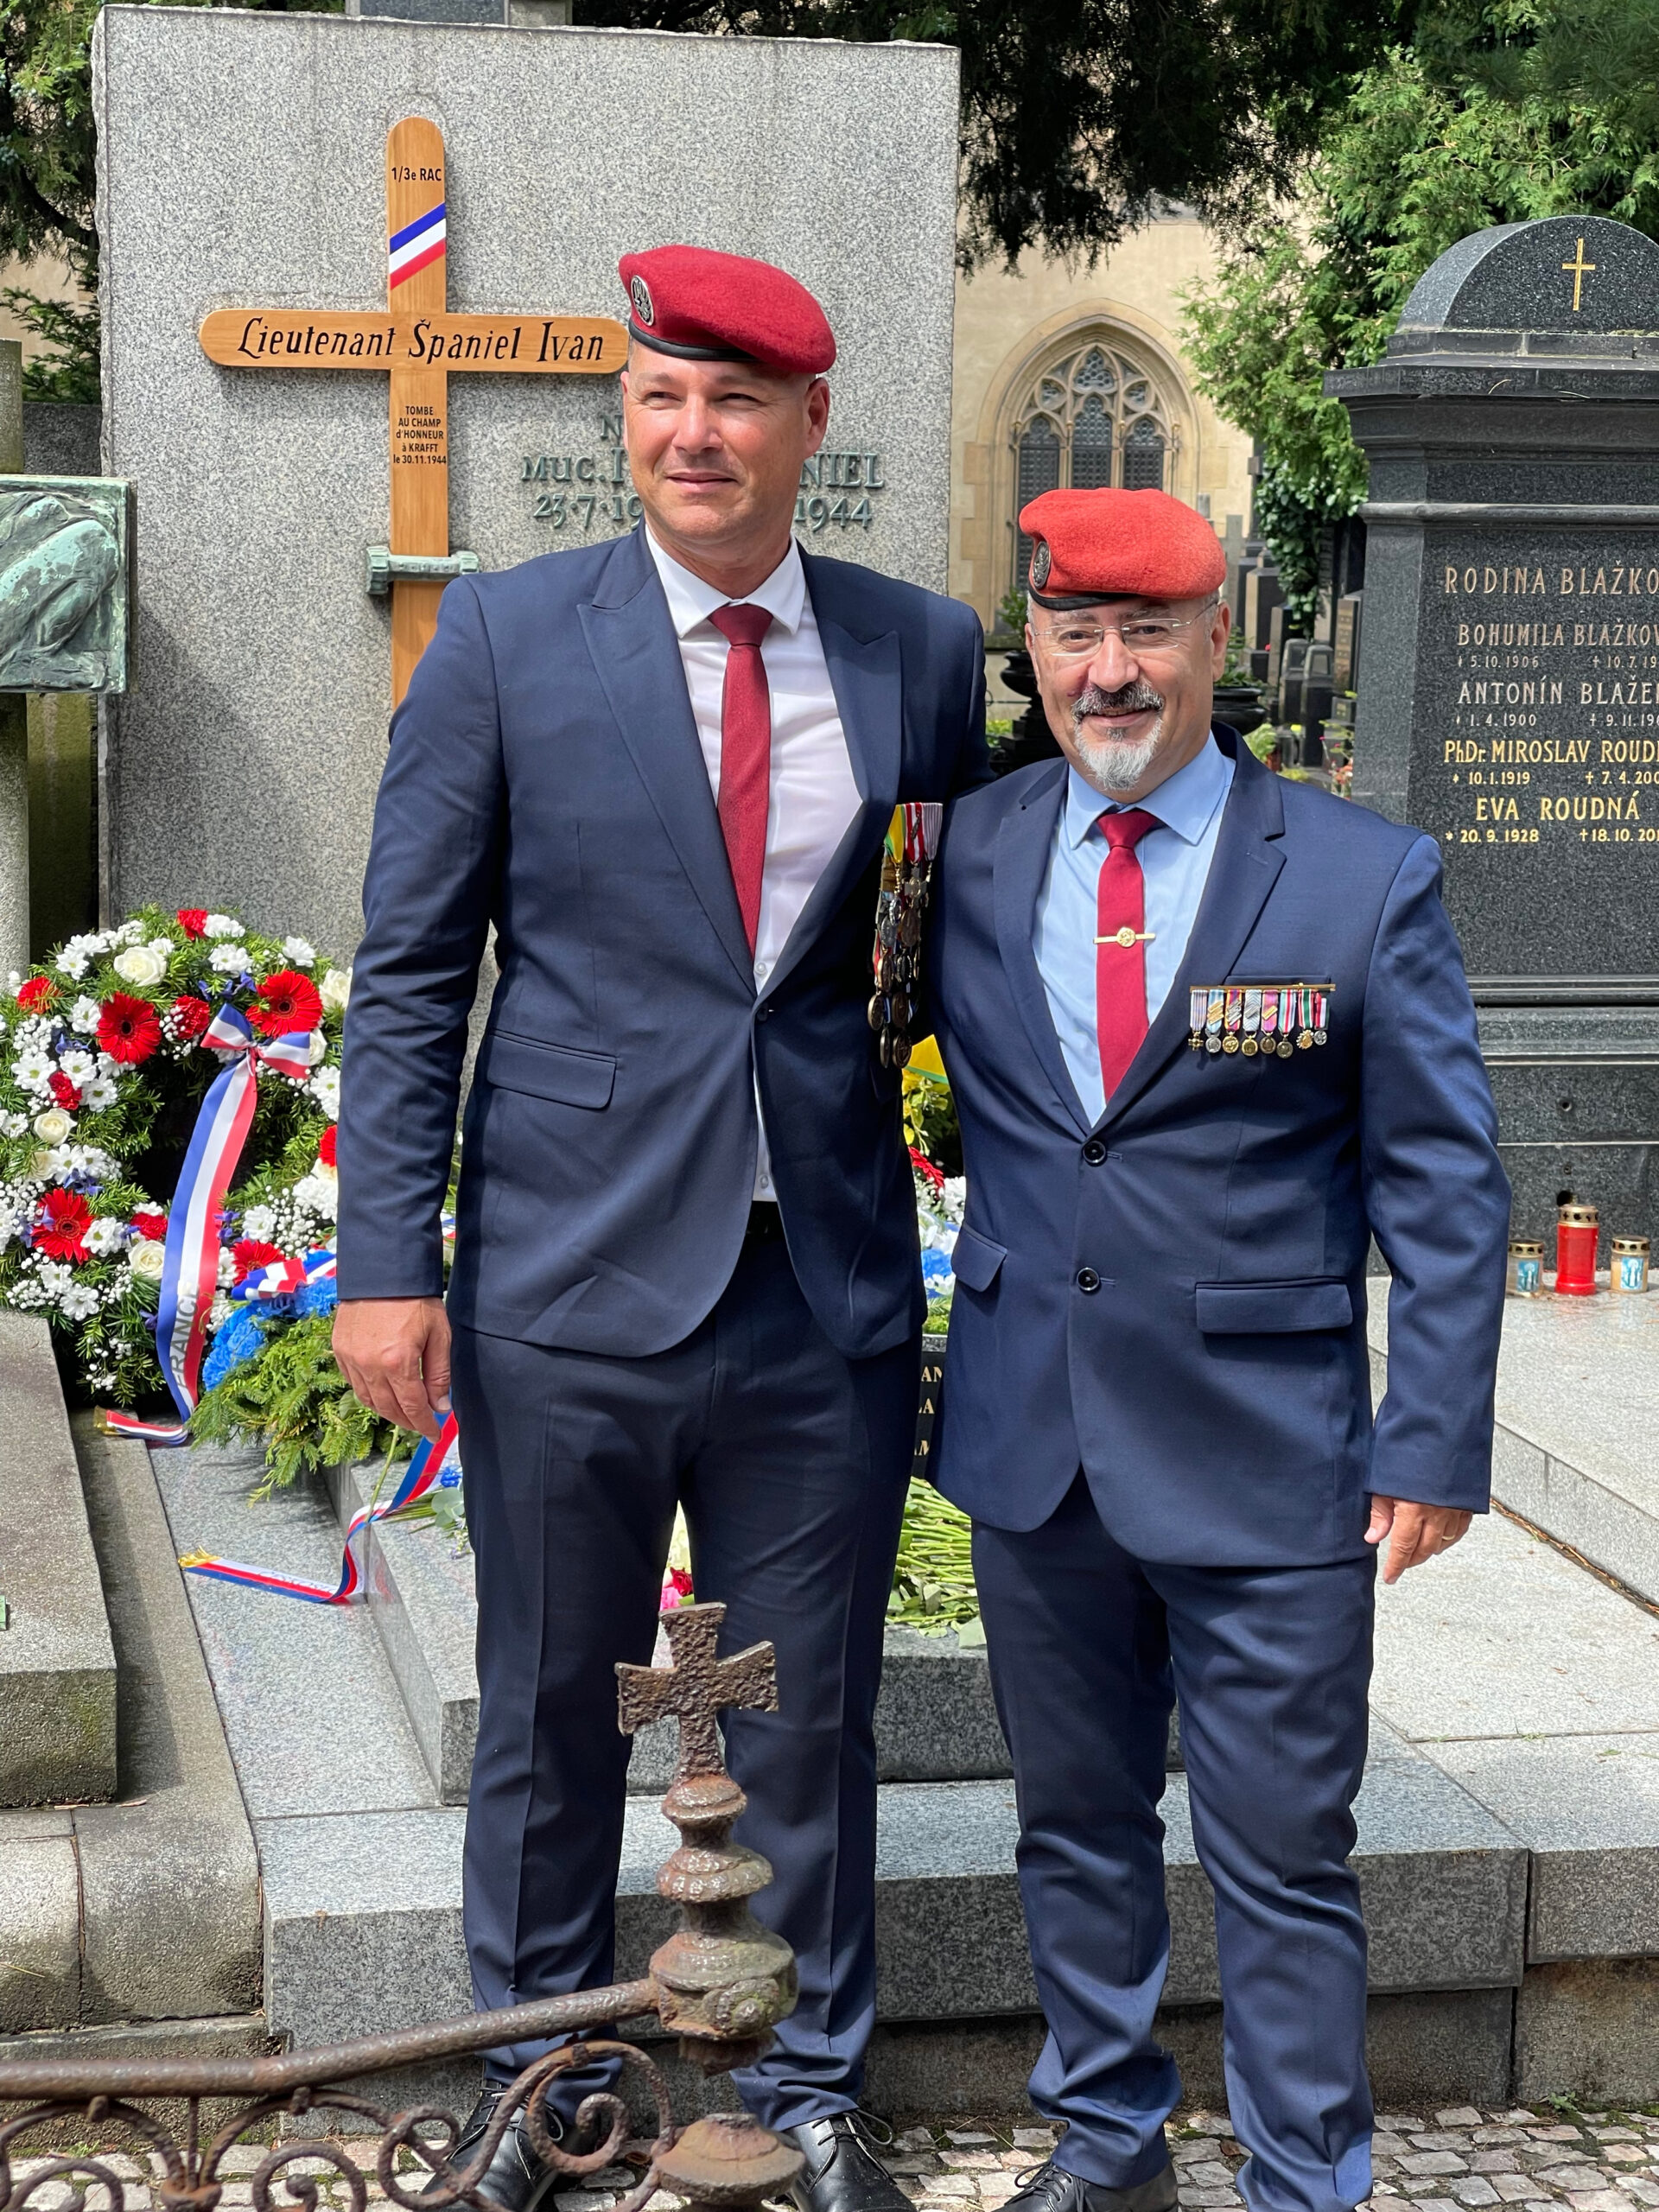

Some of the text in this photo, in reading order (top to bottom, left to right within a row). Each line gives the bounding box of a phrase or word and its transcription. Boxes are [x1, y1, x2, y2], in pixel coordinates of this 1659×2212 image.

[391, 165, 442, 182] 1/3e RAC
[237, 316, 604, 364] Lieutenant Španiel Ivan
[405, 405, 434, 416] TOMBE
[398, 417, 442, 428] AU CHAMP
[396, 429, 444, 439] d'HONNEUR
[409, 443, 438, 453] KRAFFT
[393, 454, 447, 465] le 30.11.1944
[1445, 560, 1659, 594] RODINA BLAŽKO
[1458, 623, 1565, 646] BOHUMILA
[1457, 674, 1659, 704] ANTONÍN BLAŽE
[1491, 740, 1591, 763] MIROSLAV
[1600, 740, 1659, 763] ROUD
[1476, 790, 1640, 820] EVA ROUDNÁ
